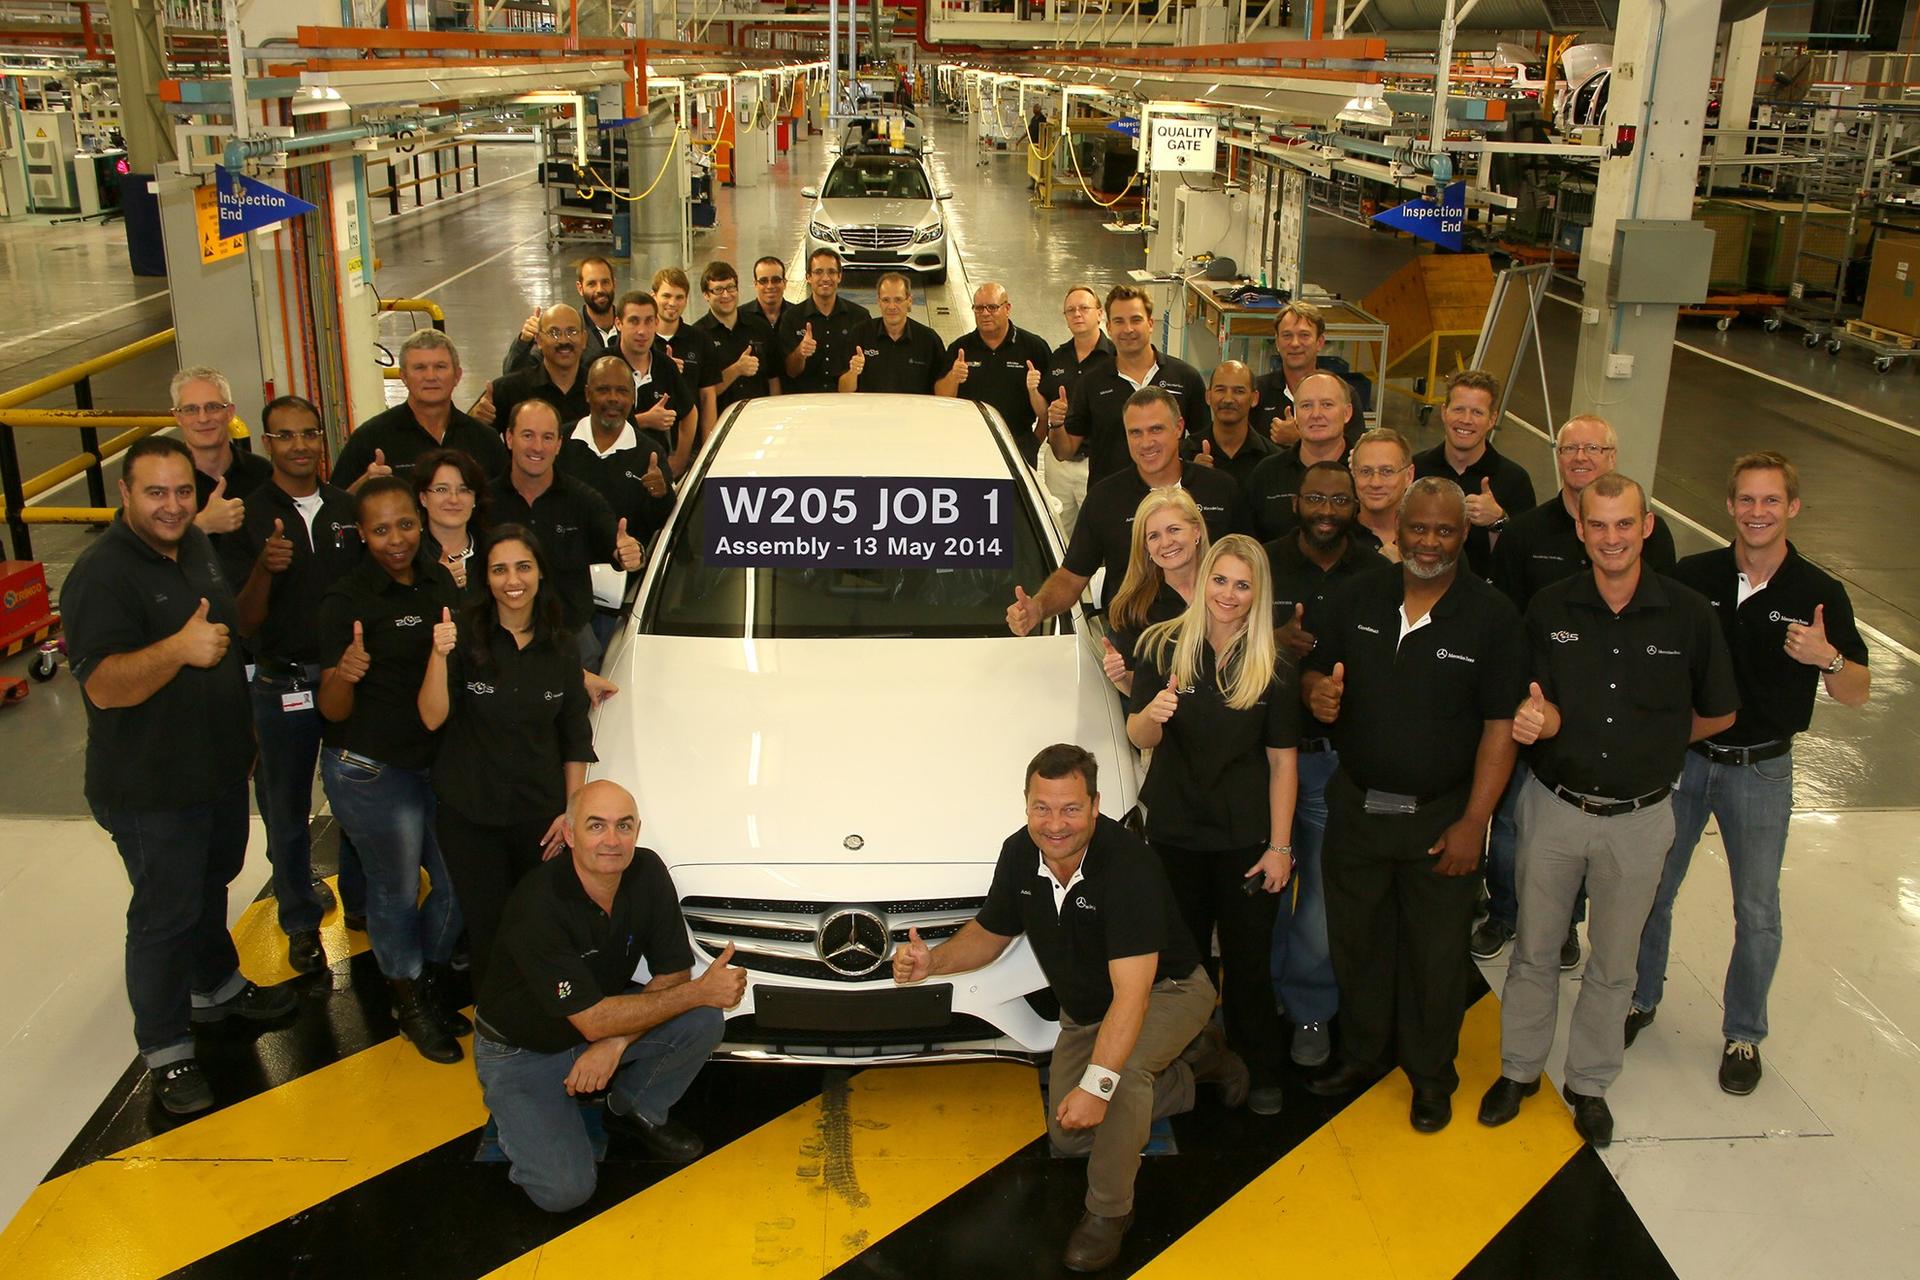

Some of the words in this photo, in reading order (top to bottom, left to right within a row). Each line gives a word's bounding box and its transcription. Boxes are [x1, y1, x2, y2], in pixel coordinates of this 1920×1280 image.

[1157, 126, 1213, 139] QUALITY
[1167, 139, 1202, 151] GATE
[219, 191, 286, 207] Inspection
[220, 207, 243, 221] End
[1402, 205, 1463, 220] Inspection
[1441, 220, 1462, 232] End
[719, 486, 858, 525] W205
[872, 487, 960, 531] JOB
[983, 488, 999, 525] 1
[715, 536, 831, 560] Assembly
[853, 537, 878, 556] 13
[887, 537, 936, 561] May
[944, 537, 1003, 556] 2014
